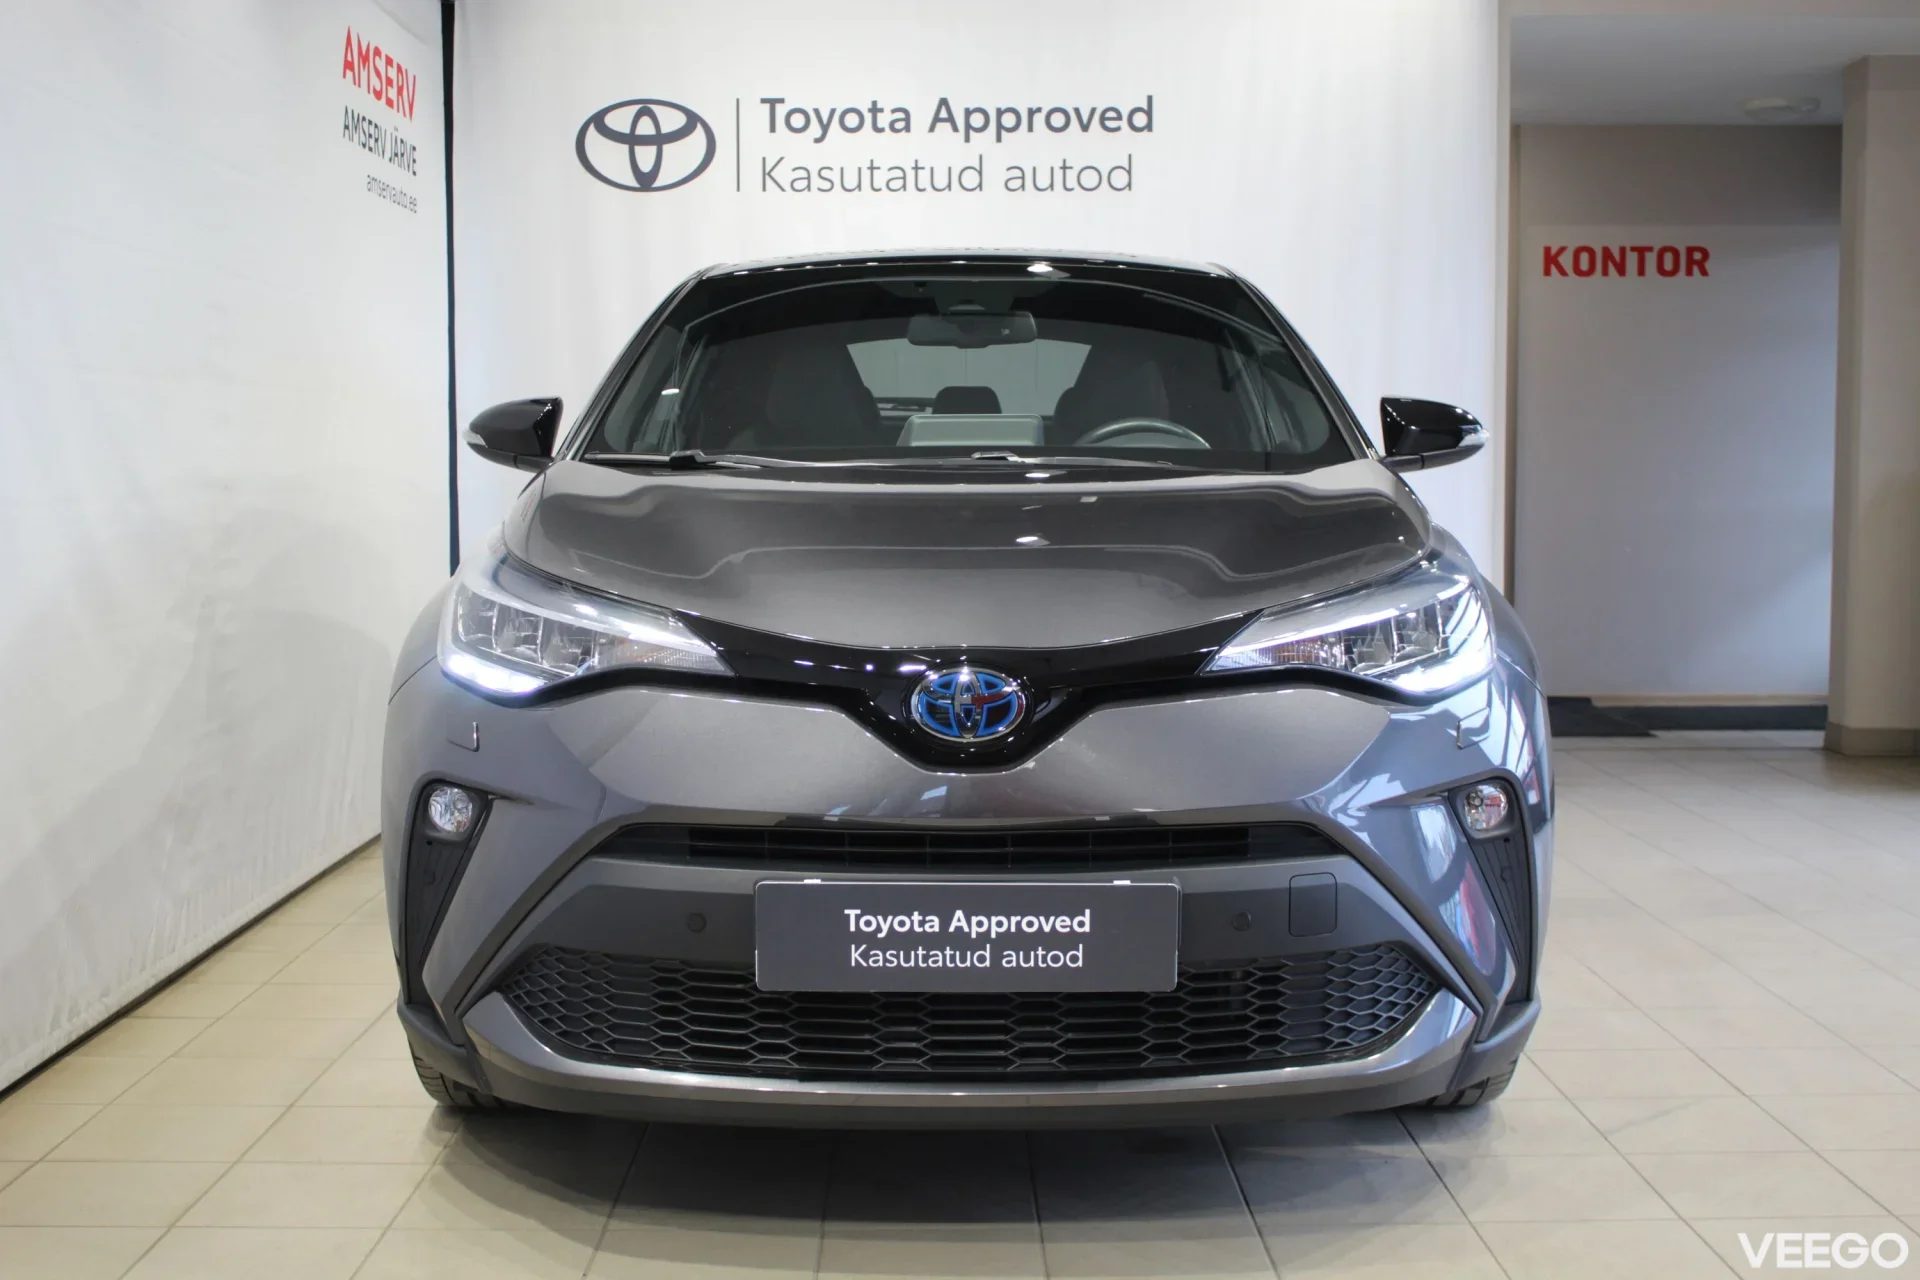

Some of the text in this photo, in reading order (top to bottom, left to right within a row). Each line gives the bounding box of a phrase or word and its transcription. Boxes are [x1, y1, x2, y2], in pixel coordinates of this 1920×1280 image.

[343, 25, 416, 123] AMSERV
[760, 95, 1154, 143] Toyota Approved
[343, 105, 417, 176] AMSERV JÄRVE
[761, 154, 1133, 192] Kasutatud autod
[367, 174, 417, 213] amservauto.ee
[1543, 245, 1710, 277] KONTOR
[844, 909, 1091, 937] Toyota Approved
[851, 944, 1083, 967] Kasutatud autod
